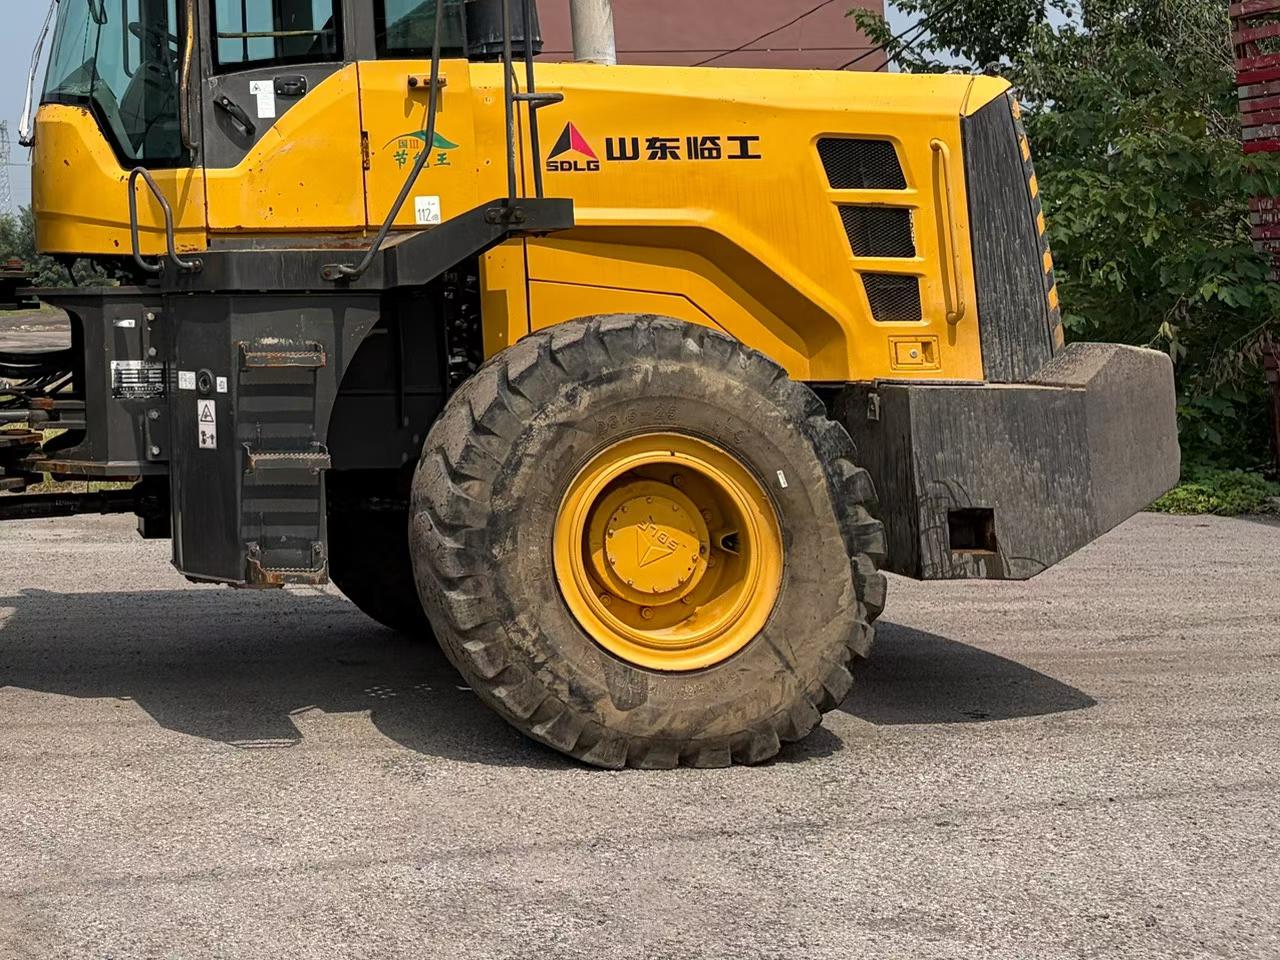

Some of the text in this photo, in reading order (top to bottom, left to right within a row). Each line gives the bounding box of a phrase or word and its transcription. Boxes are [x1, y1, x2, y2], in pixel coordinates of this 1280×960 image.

[605, 136, 762, 161] 山东临工
[546, 160, 600, 172] SDLG
